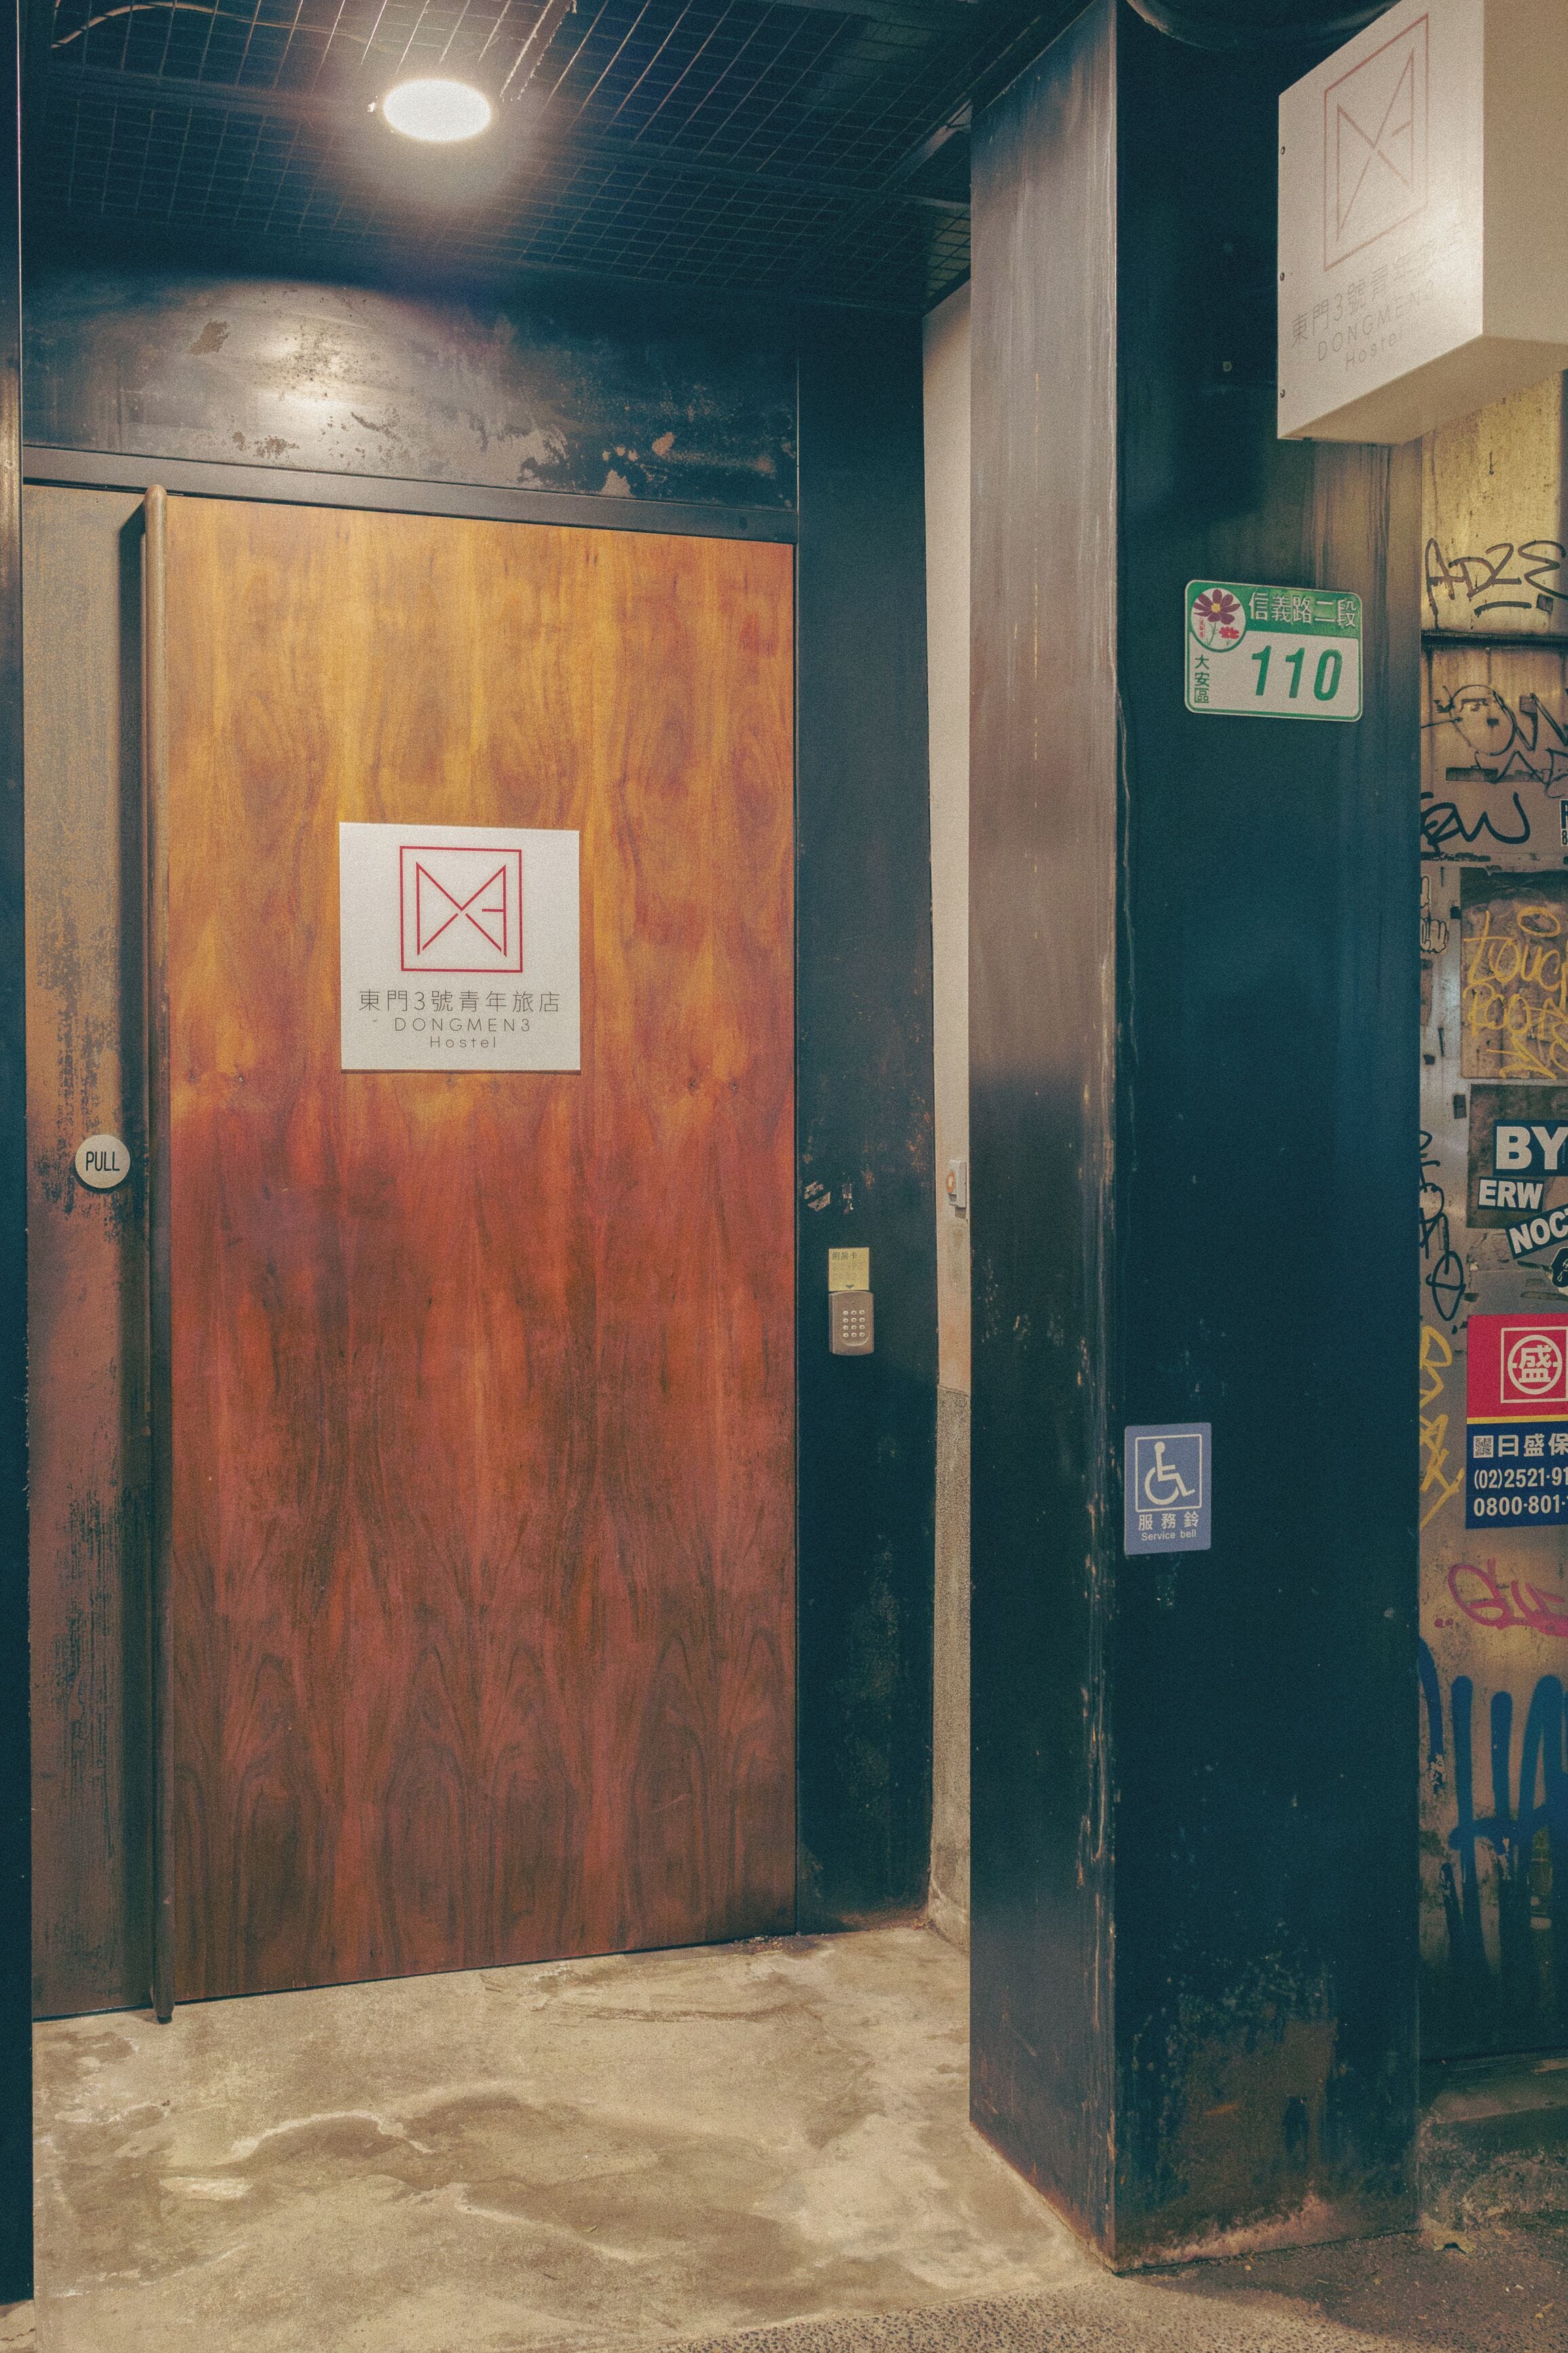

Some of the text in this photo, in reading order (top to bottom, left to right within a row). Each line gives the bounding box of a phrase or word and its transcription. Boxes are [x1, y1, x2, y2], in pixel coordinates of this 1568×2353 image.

[1318, 279, 1434, 361] DONGMEN3
[1249, 592, 1357, 628] 信義路二段
[1194, 654, 1210, 704] 大安區
[1252, 645, 1343, 701] 110
[359, 989, 560, 1013] 東門3號青年旅店
[395, 1018, 530, 1032] DONGMEN3
[430, 1036, 496, 1048] Hostel
[86, 1151, 120, 1172] PULL
[1478, 1179, 1544, 1209] ERW
[1509, 1208, 1568, 1254] NOC
[1518, 1344, 1553, 1383] 盛
[1138, 1511, 1199, 1531] 服務鈴
[1142, 1530, 1197, 1541] Service bell
